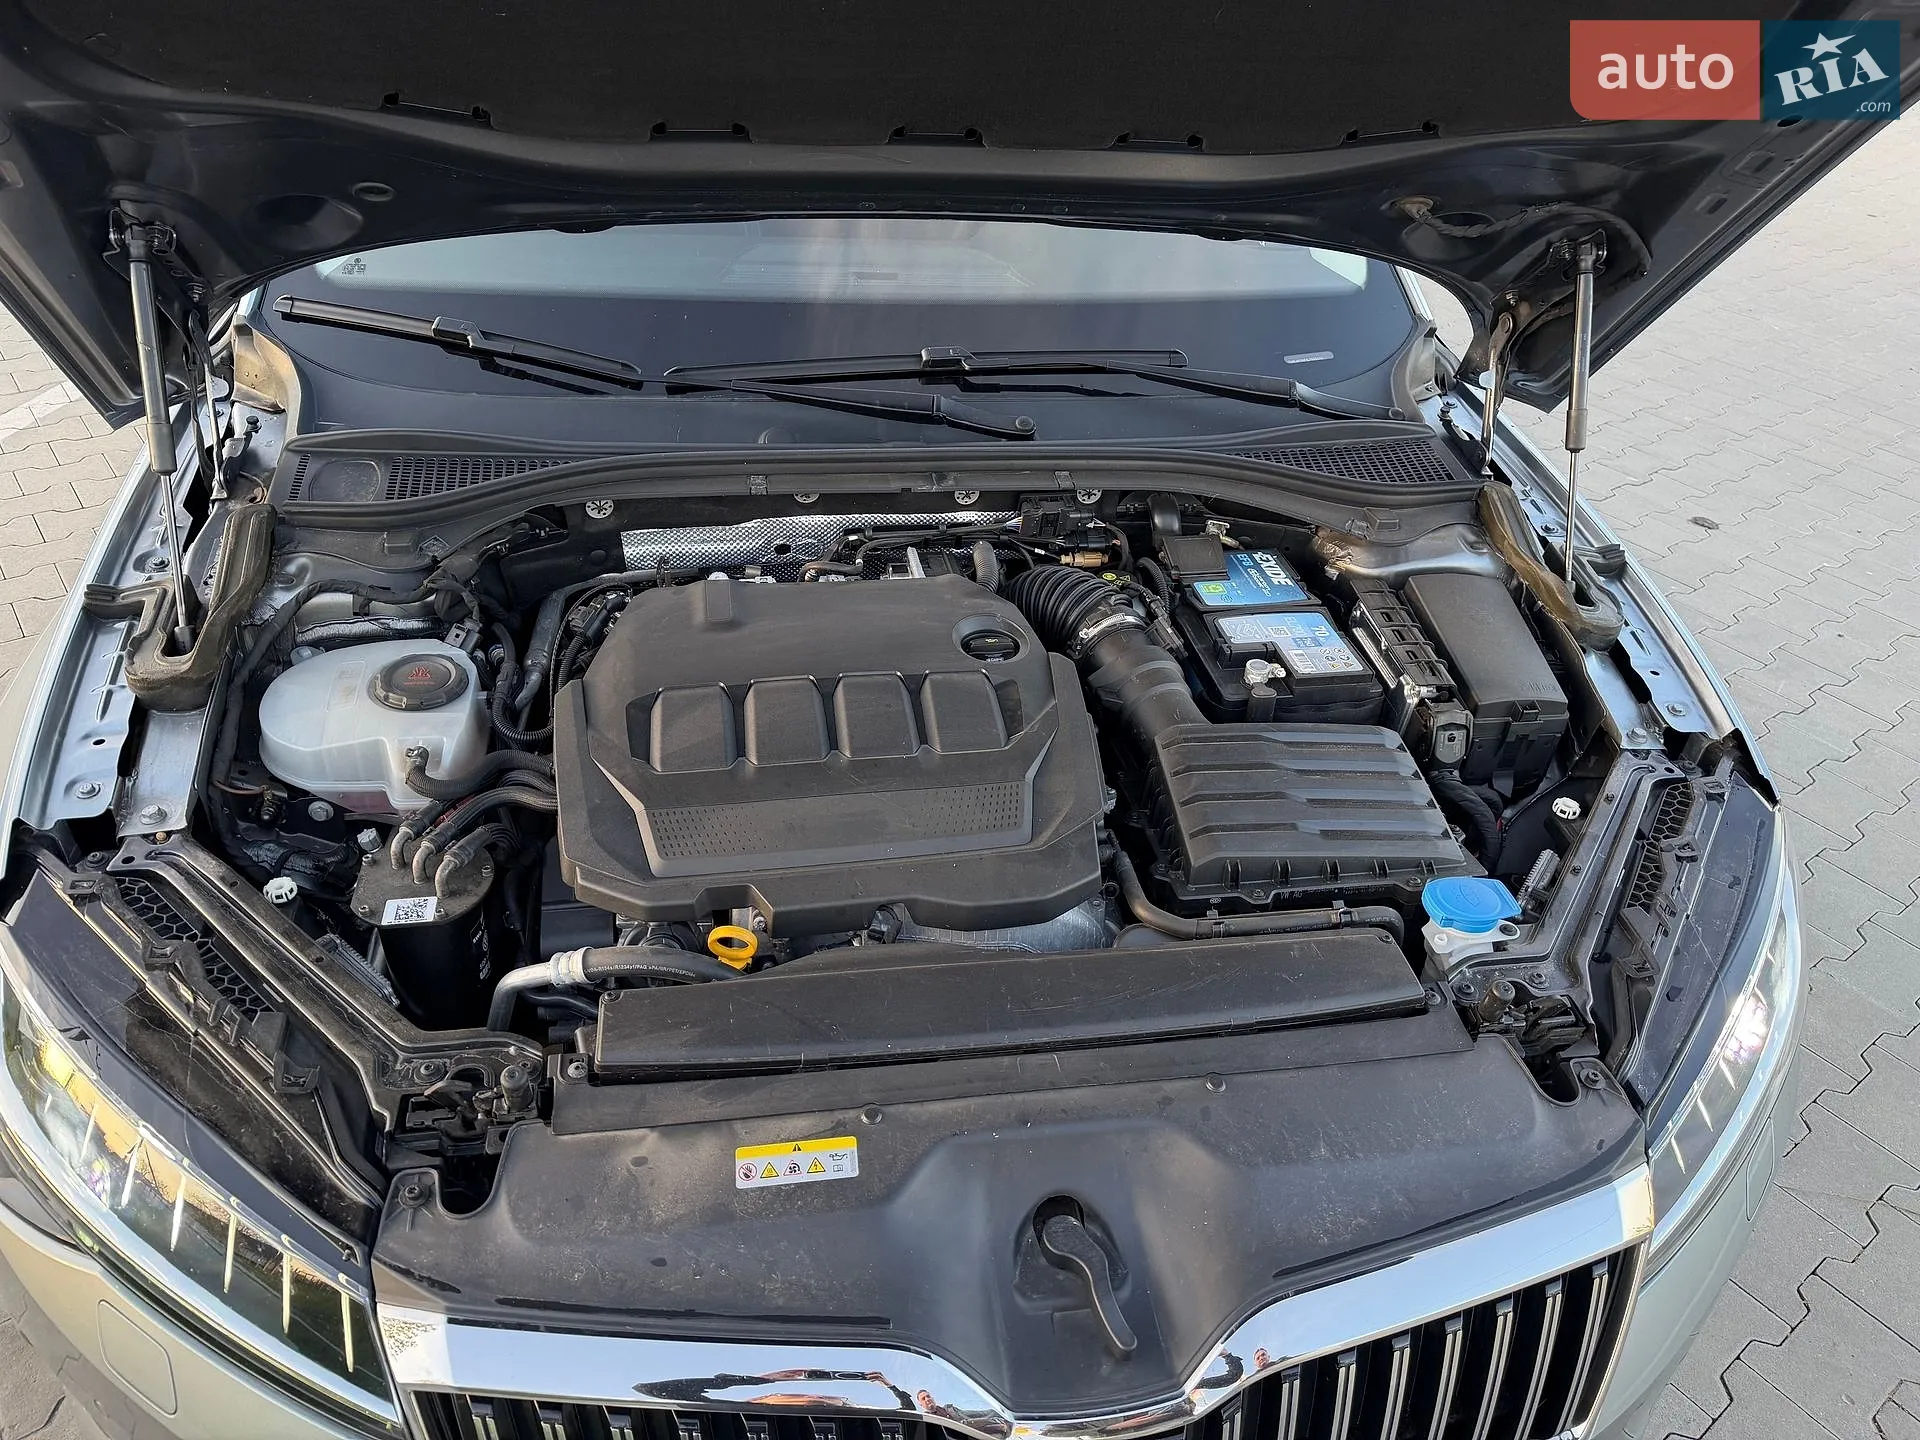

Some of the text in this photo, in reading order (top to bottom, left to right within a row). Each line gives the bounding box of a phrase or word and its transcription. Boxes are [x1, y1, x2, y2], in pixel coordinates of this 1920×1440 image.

[1236, 553, 1254, 566] EFB
[1252, 551, 1295, 587] EXIDE
[1311, 625, 1330, 637] 70
